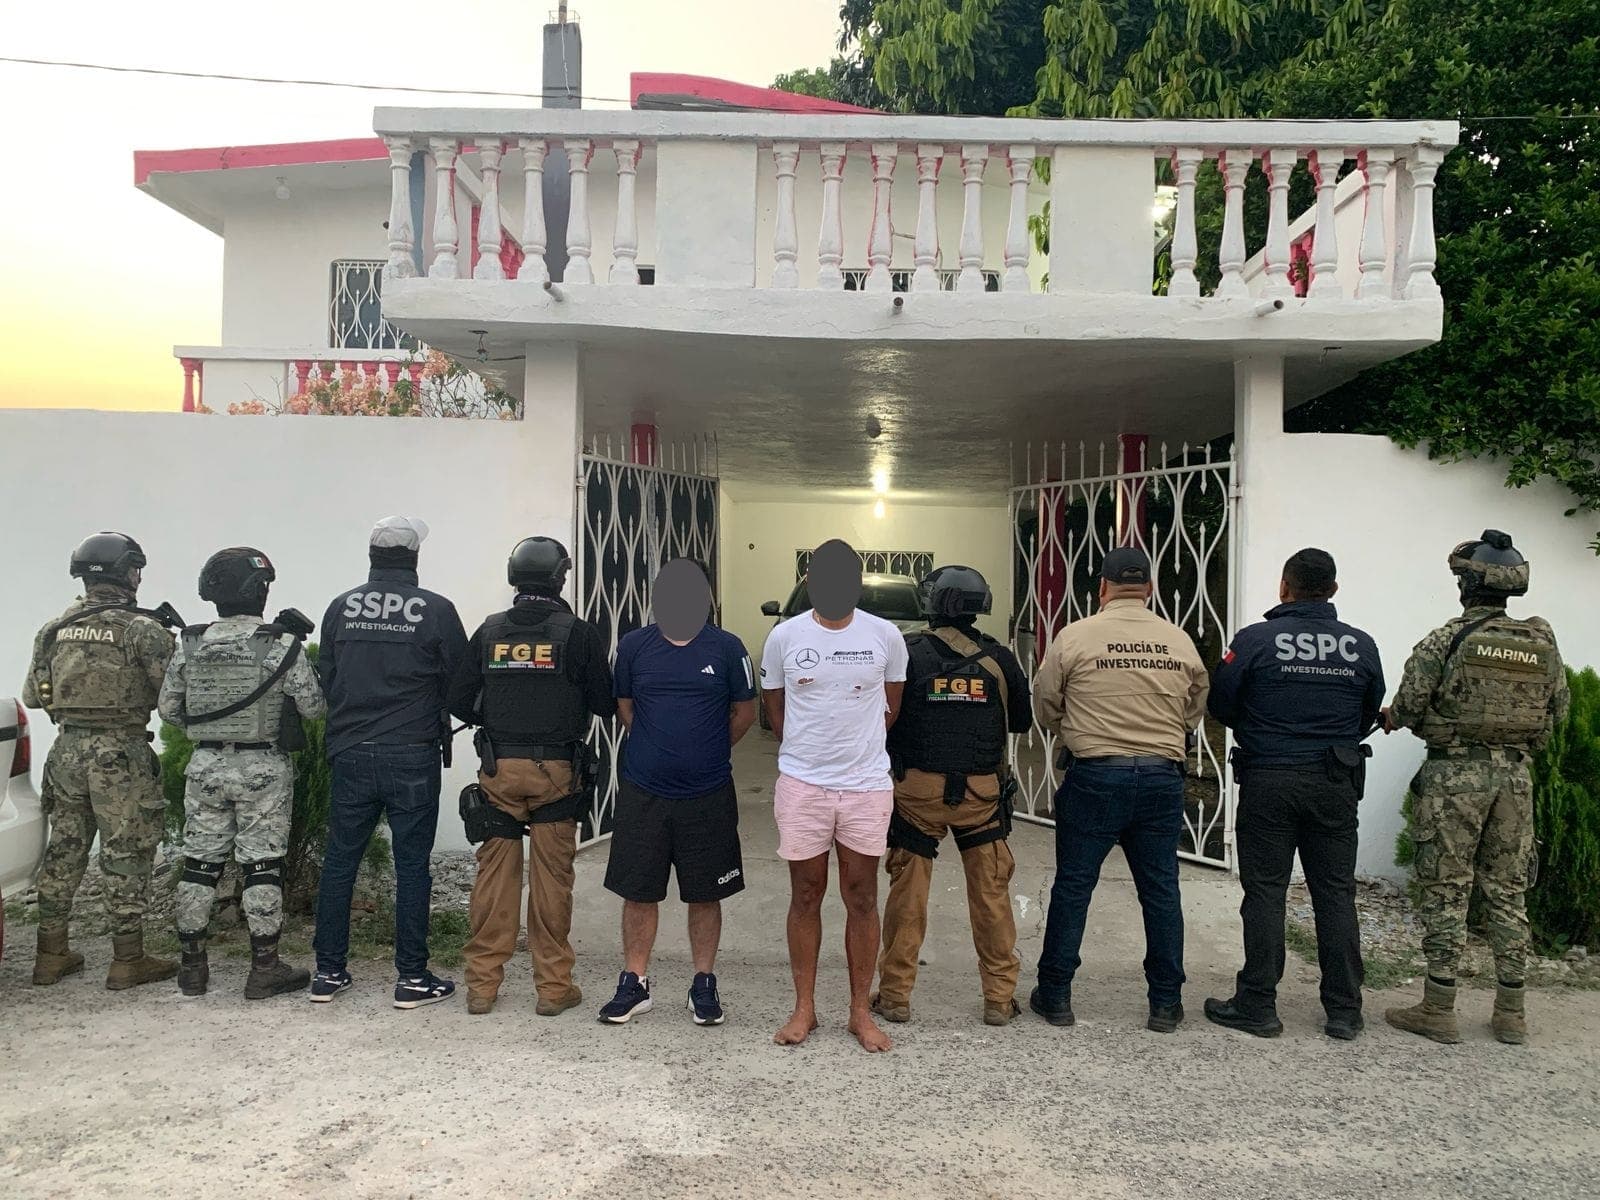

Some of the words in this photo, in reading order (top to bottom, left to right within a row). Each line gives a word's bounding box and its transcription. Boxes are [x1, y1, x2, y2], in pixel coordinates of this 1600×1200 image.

[343, 591, 427, 623] SSPC
[56, 626, 115, 643] MARINA
[345, 621, 416, 633] INVESTIGACIÓN
[494, 643, 552, 662] FGE
[1107, 641, 1153, 654] POLICÍA
[1154, 644, 1169, 655] DE
[1274, 632, 1360, 663] SSPC
[1476, 644, 1538, 665] MARINA
[1096, 657, 1182, 672] INVESTIGACIÓN
[1281, 665, 1356, 677] INVESTIGACIÓN
[934, 678, 984, 695] FGE
